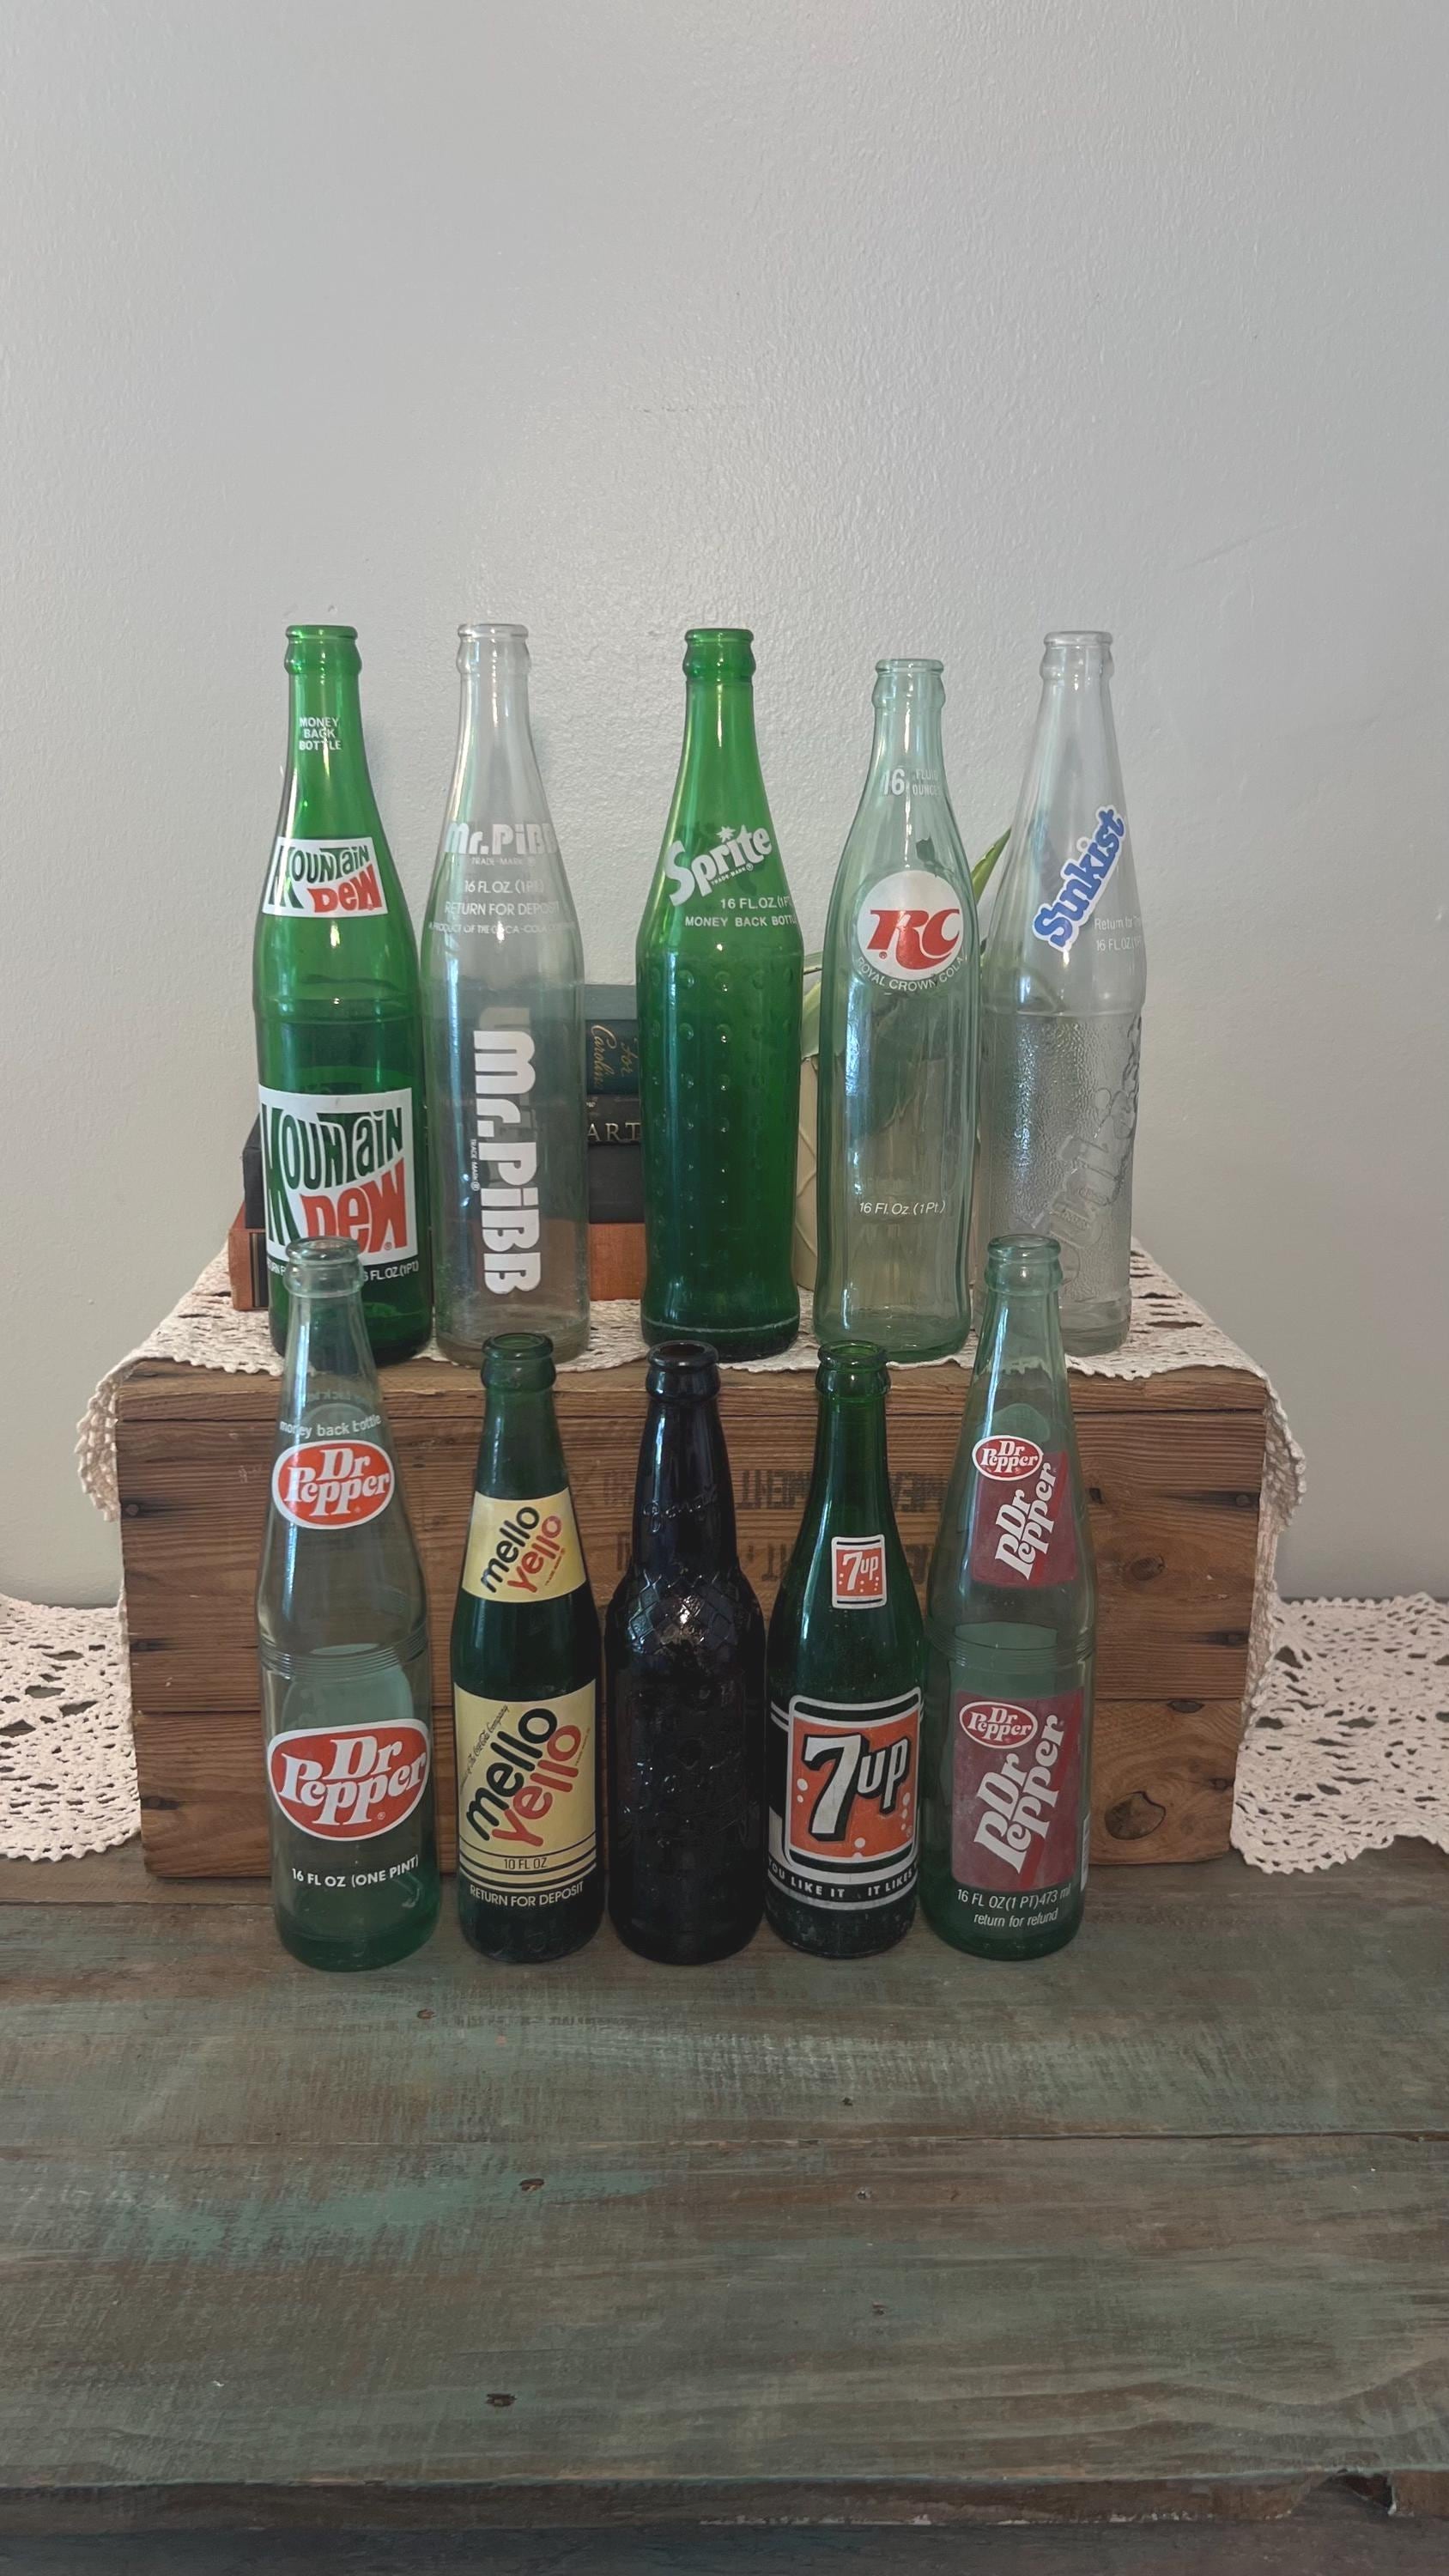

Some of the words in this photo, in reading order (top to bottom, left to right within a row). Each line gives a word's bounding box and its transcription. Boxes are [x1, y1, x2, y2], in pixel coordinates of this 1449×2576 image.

[299, 717, 339, 728] MONEY
[303, 728, 336, 739] BACK
[299, 740, 342, 750] BOTTLE
[882, 769, 906, 796] 16
[664, 824, 773, 908] Sprite
[1033, 807, 1126, 948] Sunkist
[464, 880, 476, 893] 16
[445, 902, 487, 915] RETURN
[489, 902, 515, 915] FOR
[720, 898, 736, 909] 16
[685, 916, 728, 927] MONEY
[735, 916, 767, 927] BACK
[1094, 917, 1124, 931] Return
[867, 909, 960, 969] RC
[1095, 939, 1106, 951] 16
[858, 957, 885, 986] ROYAL
[889, 978, 937, 992] CROWN
[939, 956, 964, 983] COLA
[859, 1202, 872, 1213] 16
[279, 1420, 312, 1439] money
[317, 1422, 350, 1437] back
[352, 1413, 382, 1433] bottle
[980, 1448, 1039, 1473] Pepper
[997, 1440, 1025, 1456] Dr
[316, 1447, 371, 1481] Dr
[284, 1466, 390, 1517] Pepper
[994, 1462, 1057, 1581] Pepper
[995, 1489, 1031, 1542] Dr
[480, 1505, 541, 1594] mello
[506, 1515, 562, 1594] yello
[967, 1713, 1033, 1741] Pepper
[987, 1706, 1018, 1724] Dr
[323, 1735, 403, 1781] Dr
[465, 1707, 559, 1841] mello
[492, 1724, 582, 1847] yello
[976, 1753, 1029, 1820] Dr
[278, 1750, 427, 1826] Pepper
[973, 1714, 1064, 1874] Pepper
[292, 1868, 304, 1882] 16
[307, 1873, 321, 1886] FL
[324, 1875, 346, 1888] OZ
[351, 1872, 386, 1889] (ONE
[389, 1854, 419, 1880] PINT)
[504, 1858, 515, 1870] 10
[518, 1858, 531, 1870] FL
[533, 1857, 547, 1869] OZ
[768, 1857, 785, 1879] YOU
[791, 1876, 822, 1896] LIKE
[831, 1889, 845, 1899] IT
[868, 1886, 881, 1897] IT
[885, 1869, 912, 1893] LIKES
[470, 1883, 509, 1907] RETURN
[511, 1895, 535, 1907] FOR
[538, 1880, 585, 1907] DEPOSIT
[957, 1889, 968, 1903] 16
[971, 1893, 985, 1907] FL
[973, 1913, 1005, 1927] return
[1009, 1915, 1024, 1928] for
[1027, 1908, 1058, 1926] refund
